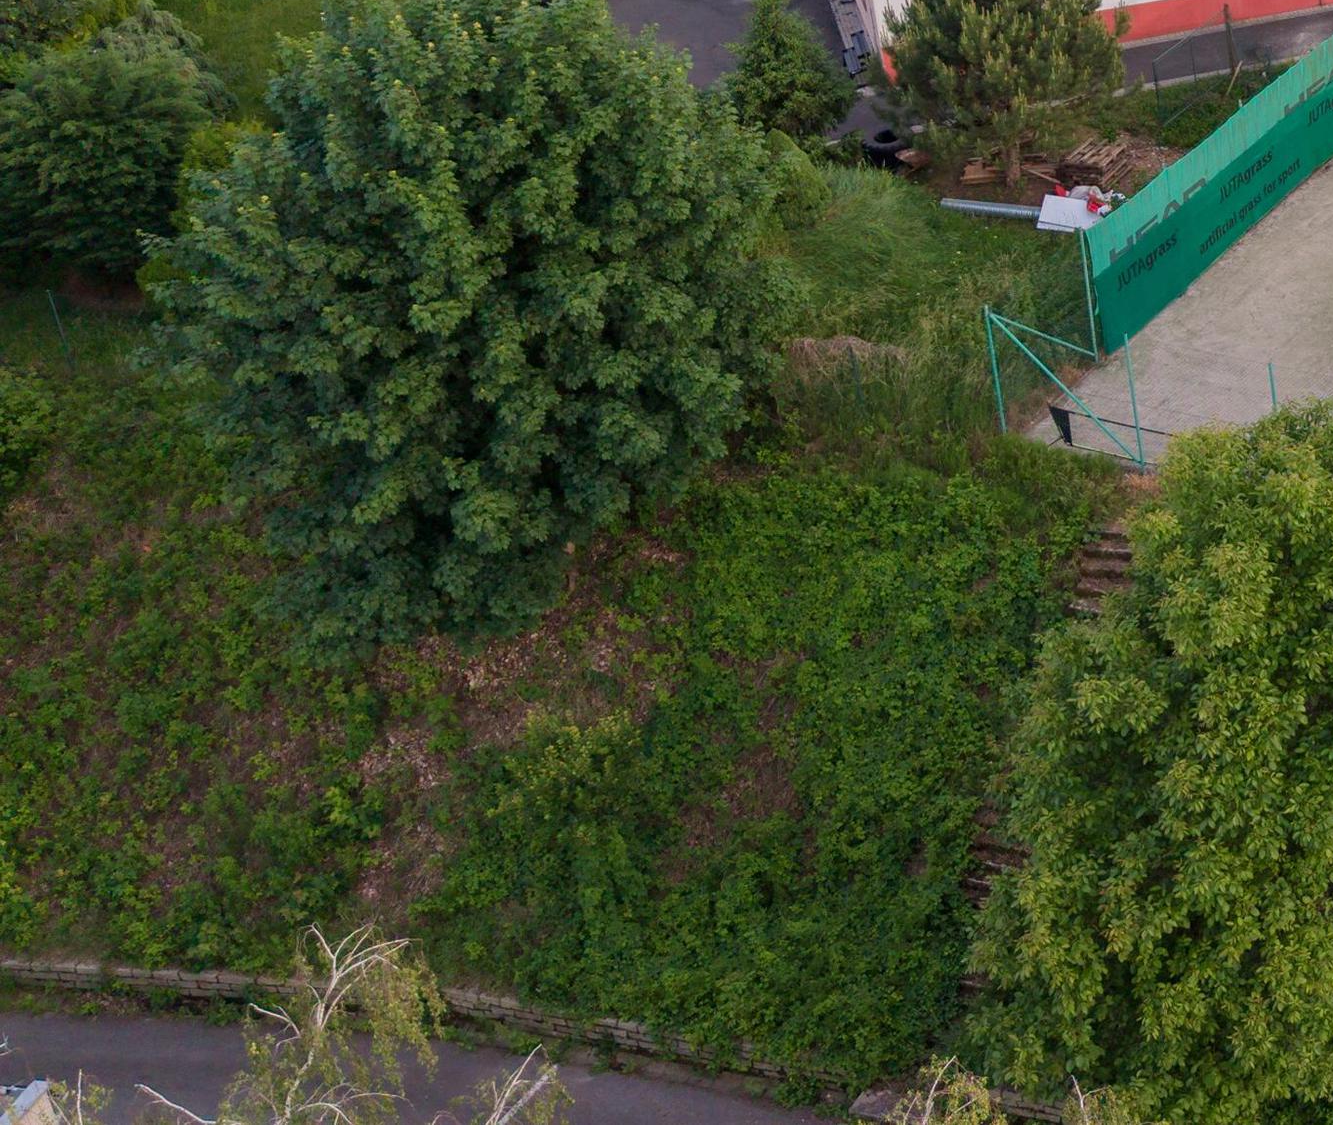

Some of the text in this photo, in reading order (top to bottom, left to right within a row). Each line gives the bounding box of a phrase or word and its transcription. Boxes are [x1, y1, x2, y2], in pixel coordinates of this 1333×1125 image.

[1220, 150, 1273, 203] JUTAgrass
[1278, 158, 1301, 185] sport
[1118, 233, 1177, 291] JUTAgrass
